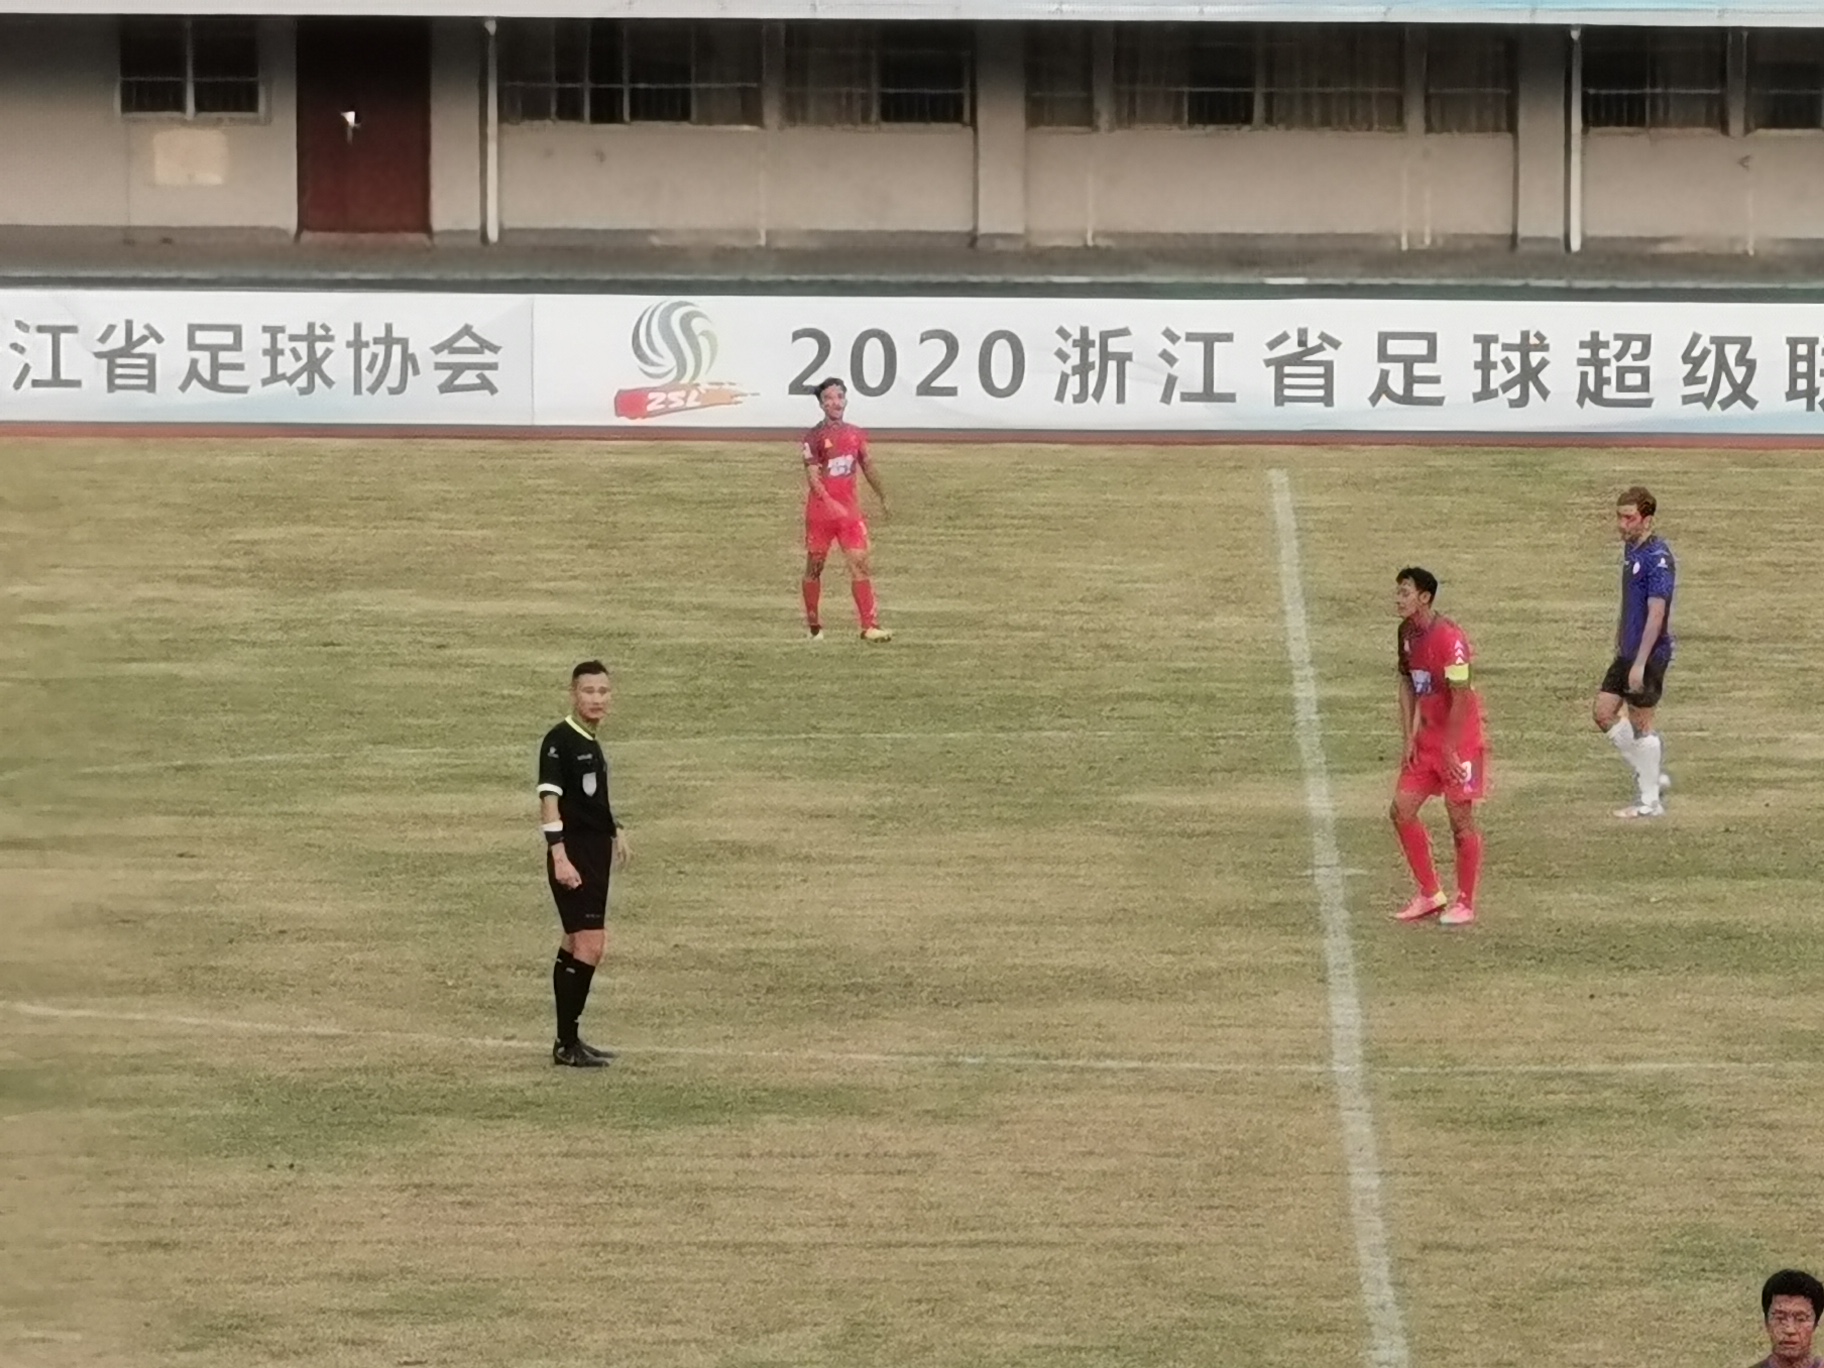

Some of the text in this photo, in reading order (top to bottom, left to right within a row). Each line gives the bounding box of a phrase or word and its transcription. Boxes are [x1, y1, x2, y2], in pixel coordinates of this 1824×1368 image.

[8, 318, 503, 397] 江省足球协会
